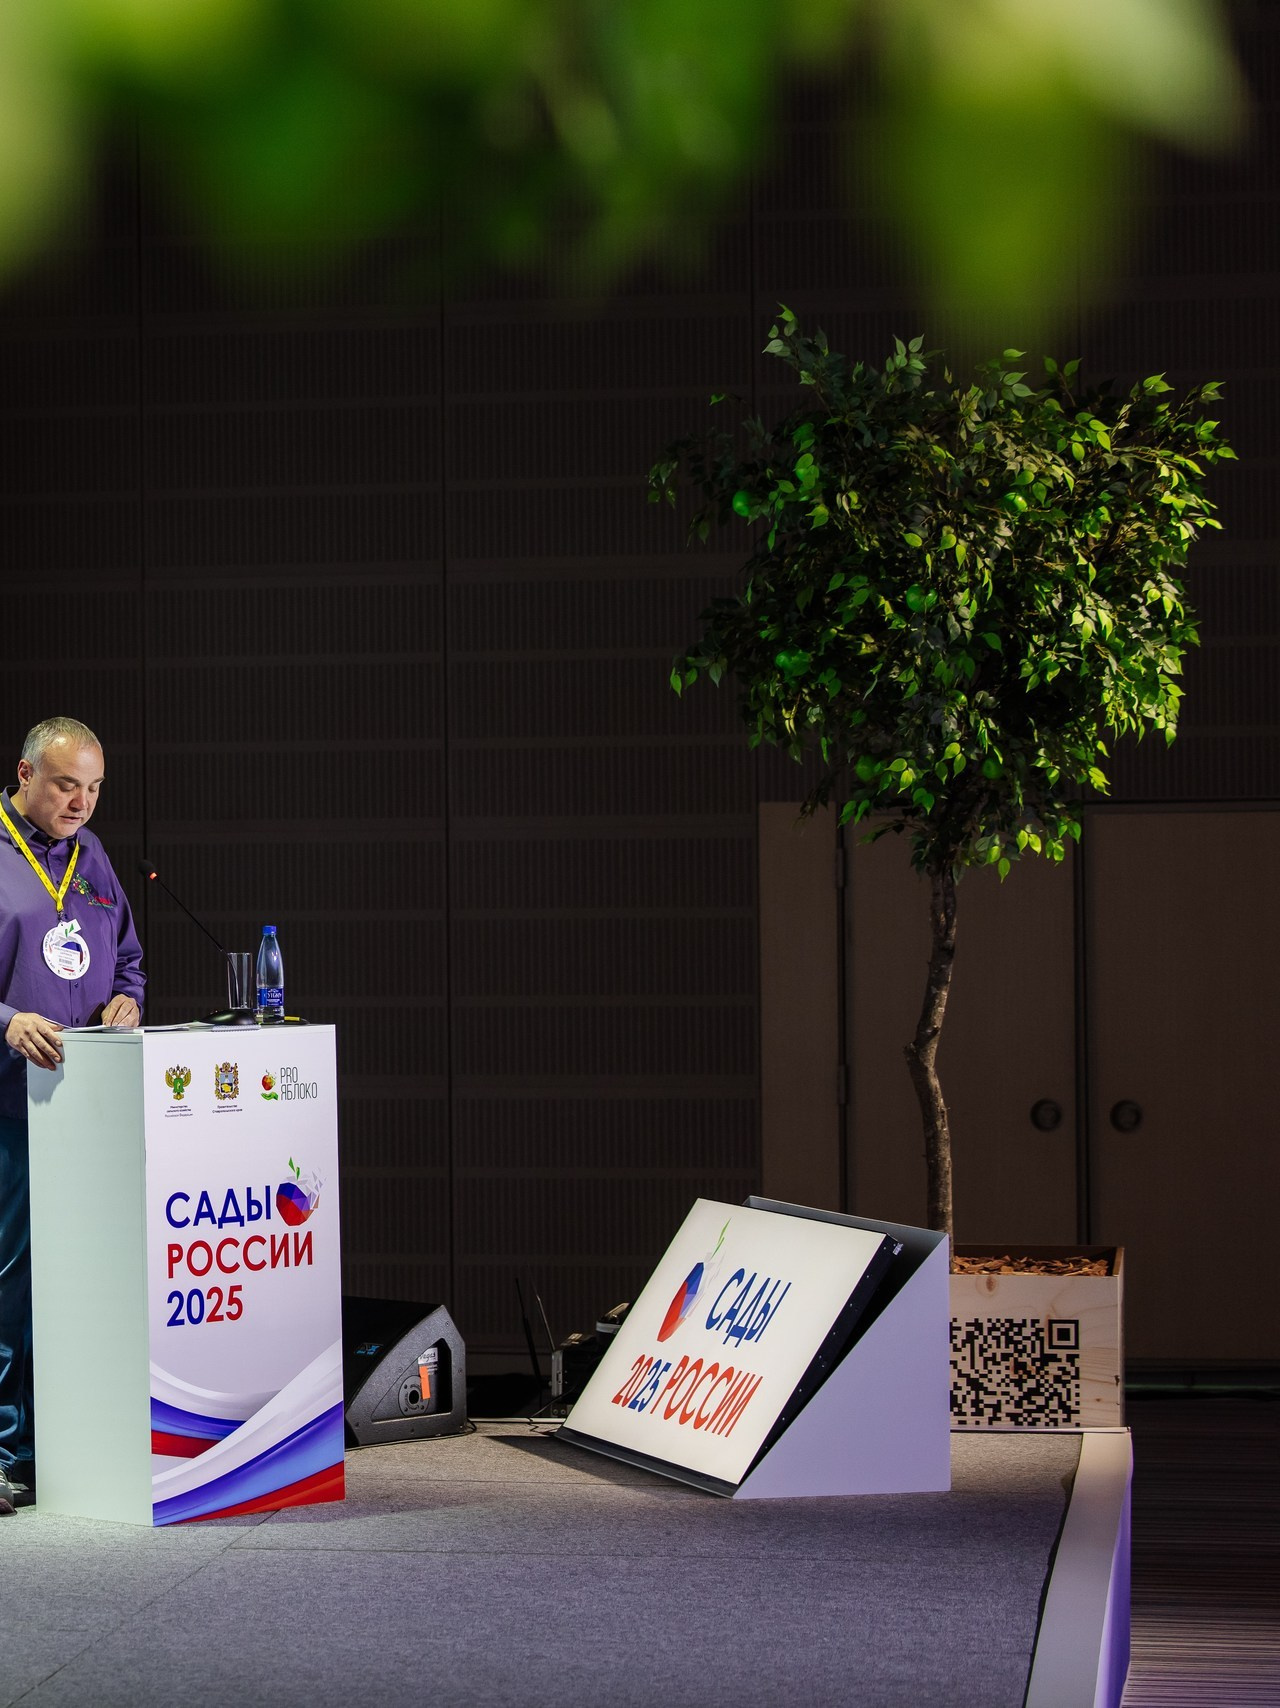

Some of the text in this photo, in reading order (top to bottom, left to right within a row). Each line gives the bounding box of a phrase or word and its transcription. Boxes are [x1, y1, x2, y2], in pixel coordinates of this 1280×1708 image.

[280, 1067, 298, 1084] PRO
[280, 1082, 318, 1101] ЯБЛОКО
[165, 1185, 272, 1229] САДЫ
[167, 1230, 313, 1279] РОССИИ
[166, 1284, 244, 1328] 2025
[705, 1267, 793, 1348] САДЫ
[611, 1353, 764, 1438] 2025 РОССИИ
